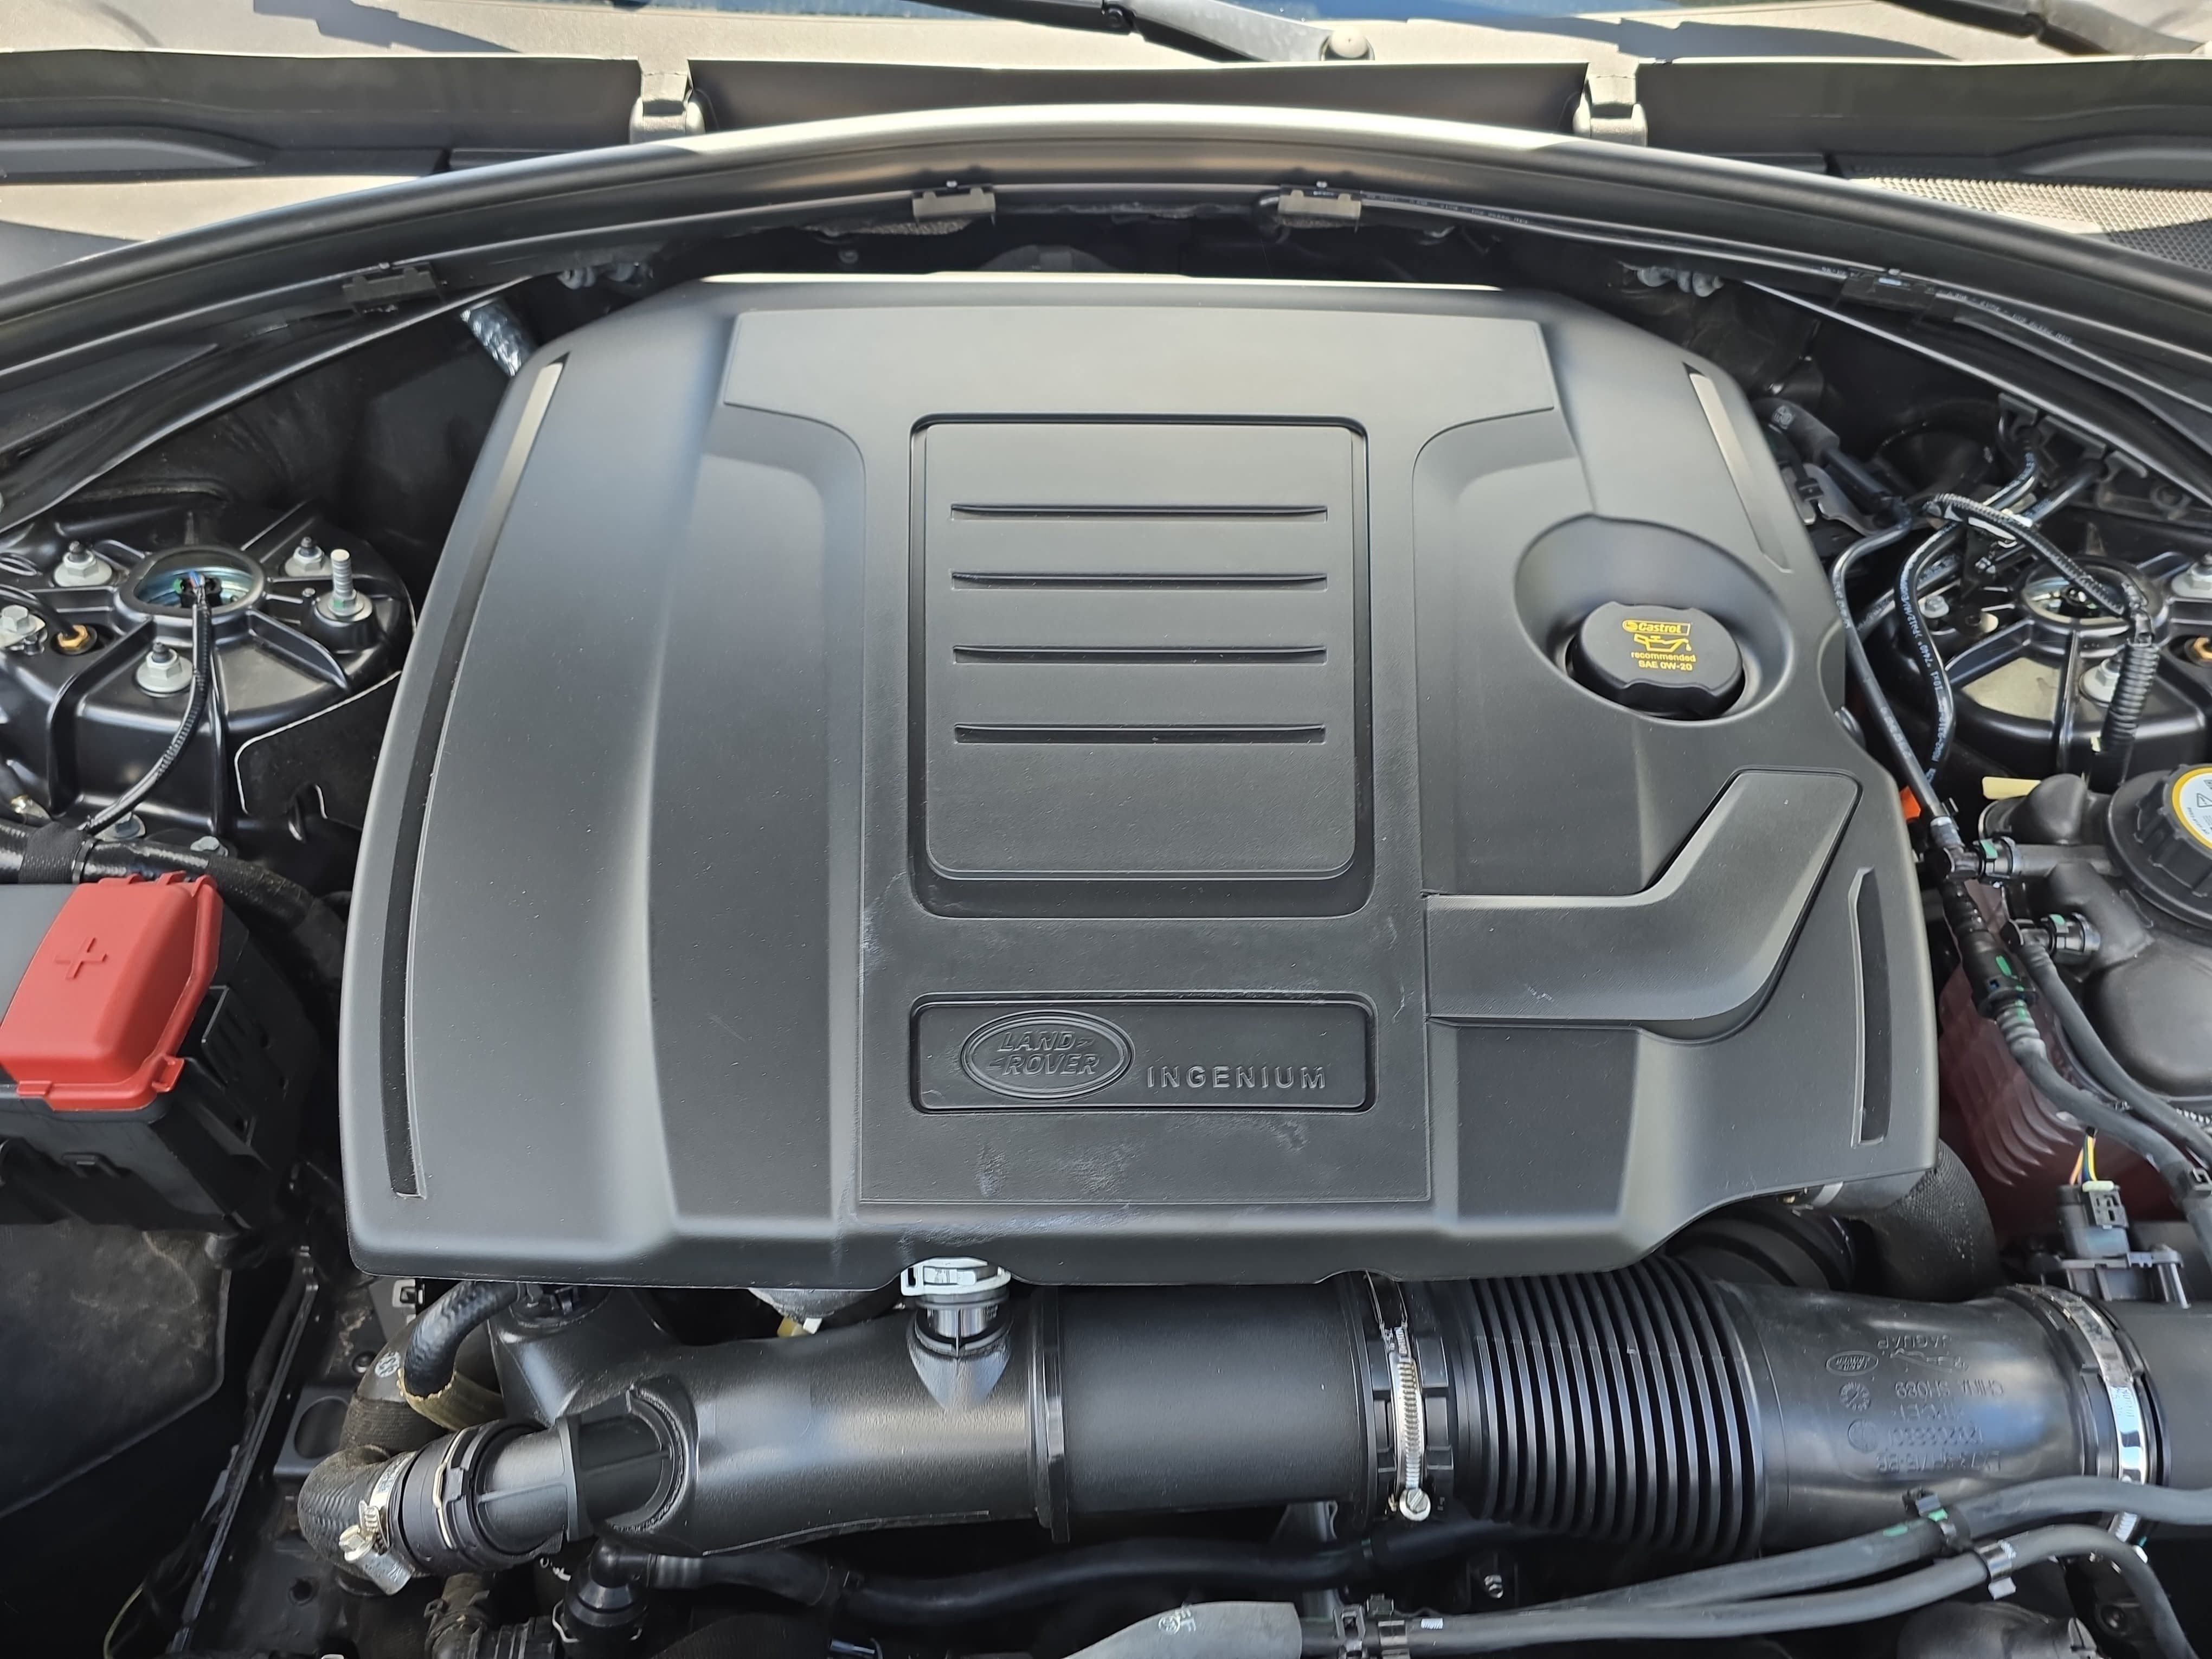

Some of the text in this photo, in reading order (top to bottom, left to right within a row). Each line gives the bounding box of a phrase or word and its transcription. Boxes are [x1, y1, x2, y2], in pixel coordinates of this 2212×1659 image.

[1638, 622, 1681, 633] Castrol
[1631, 652, 1696, 662] recommended
[1638, 660, 1693, 671] SAE 0W-20
[996, 1031, 1076, 1052] LAND
[1002, 1053, 1102, 1076] ROVER
[1147, 1066, 1326, 1089] INGENIUM
